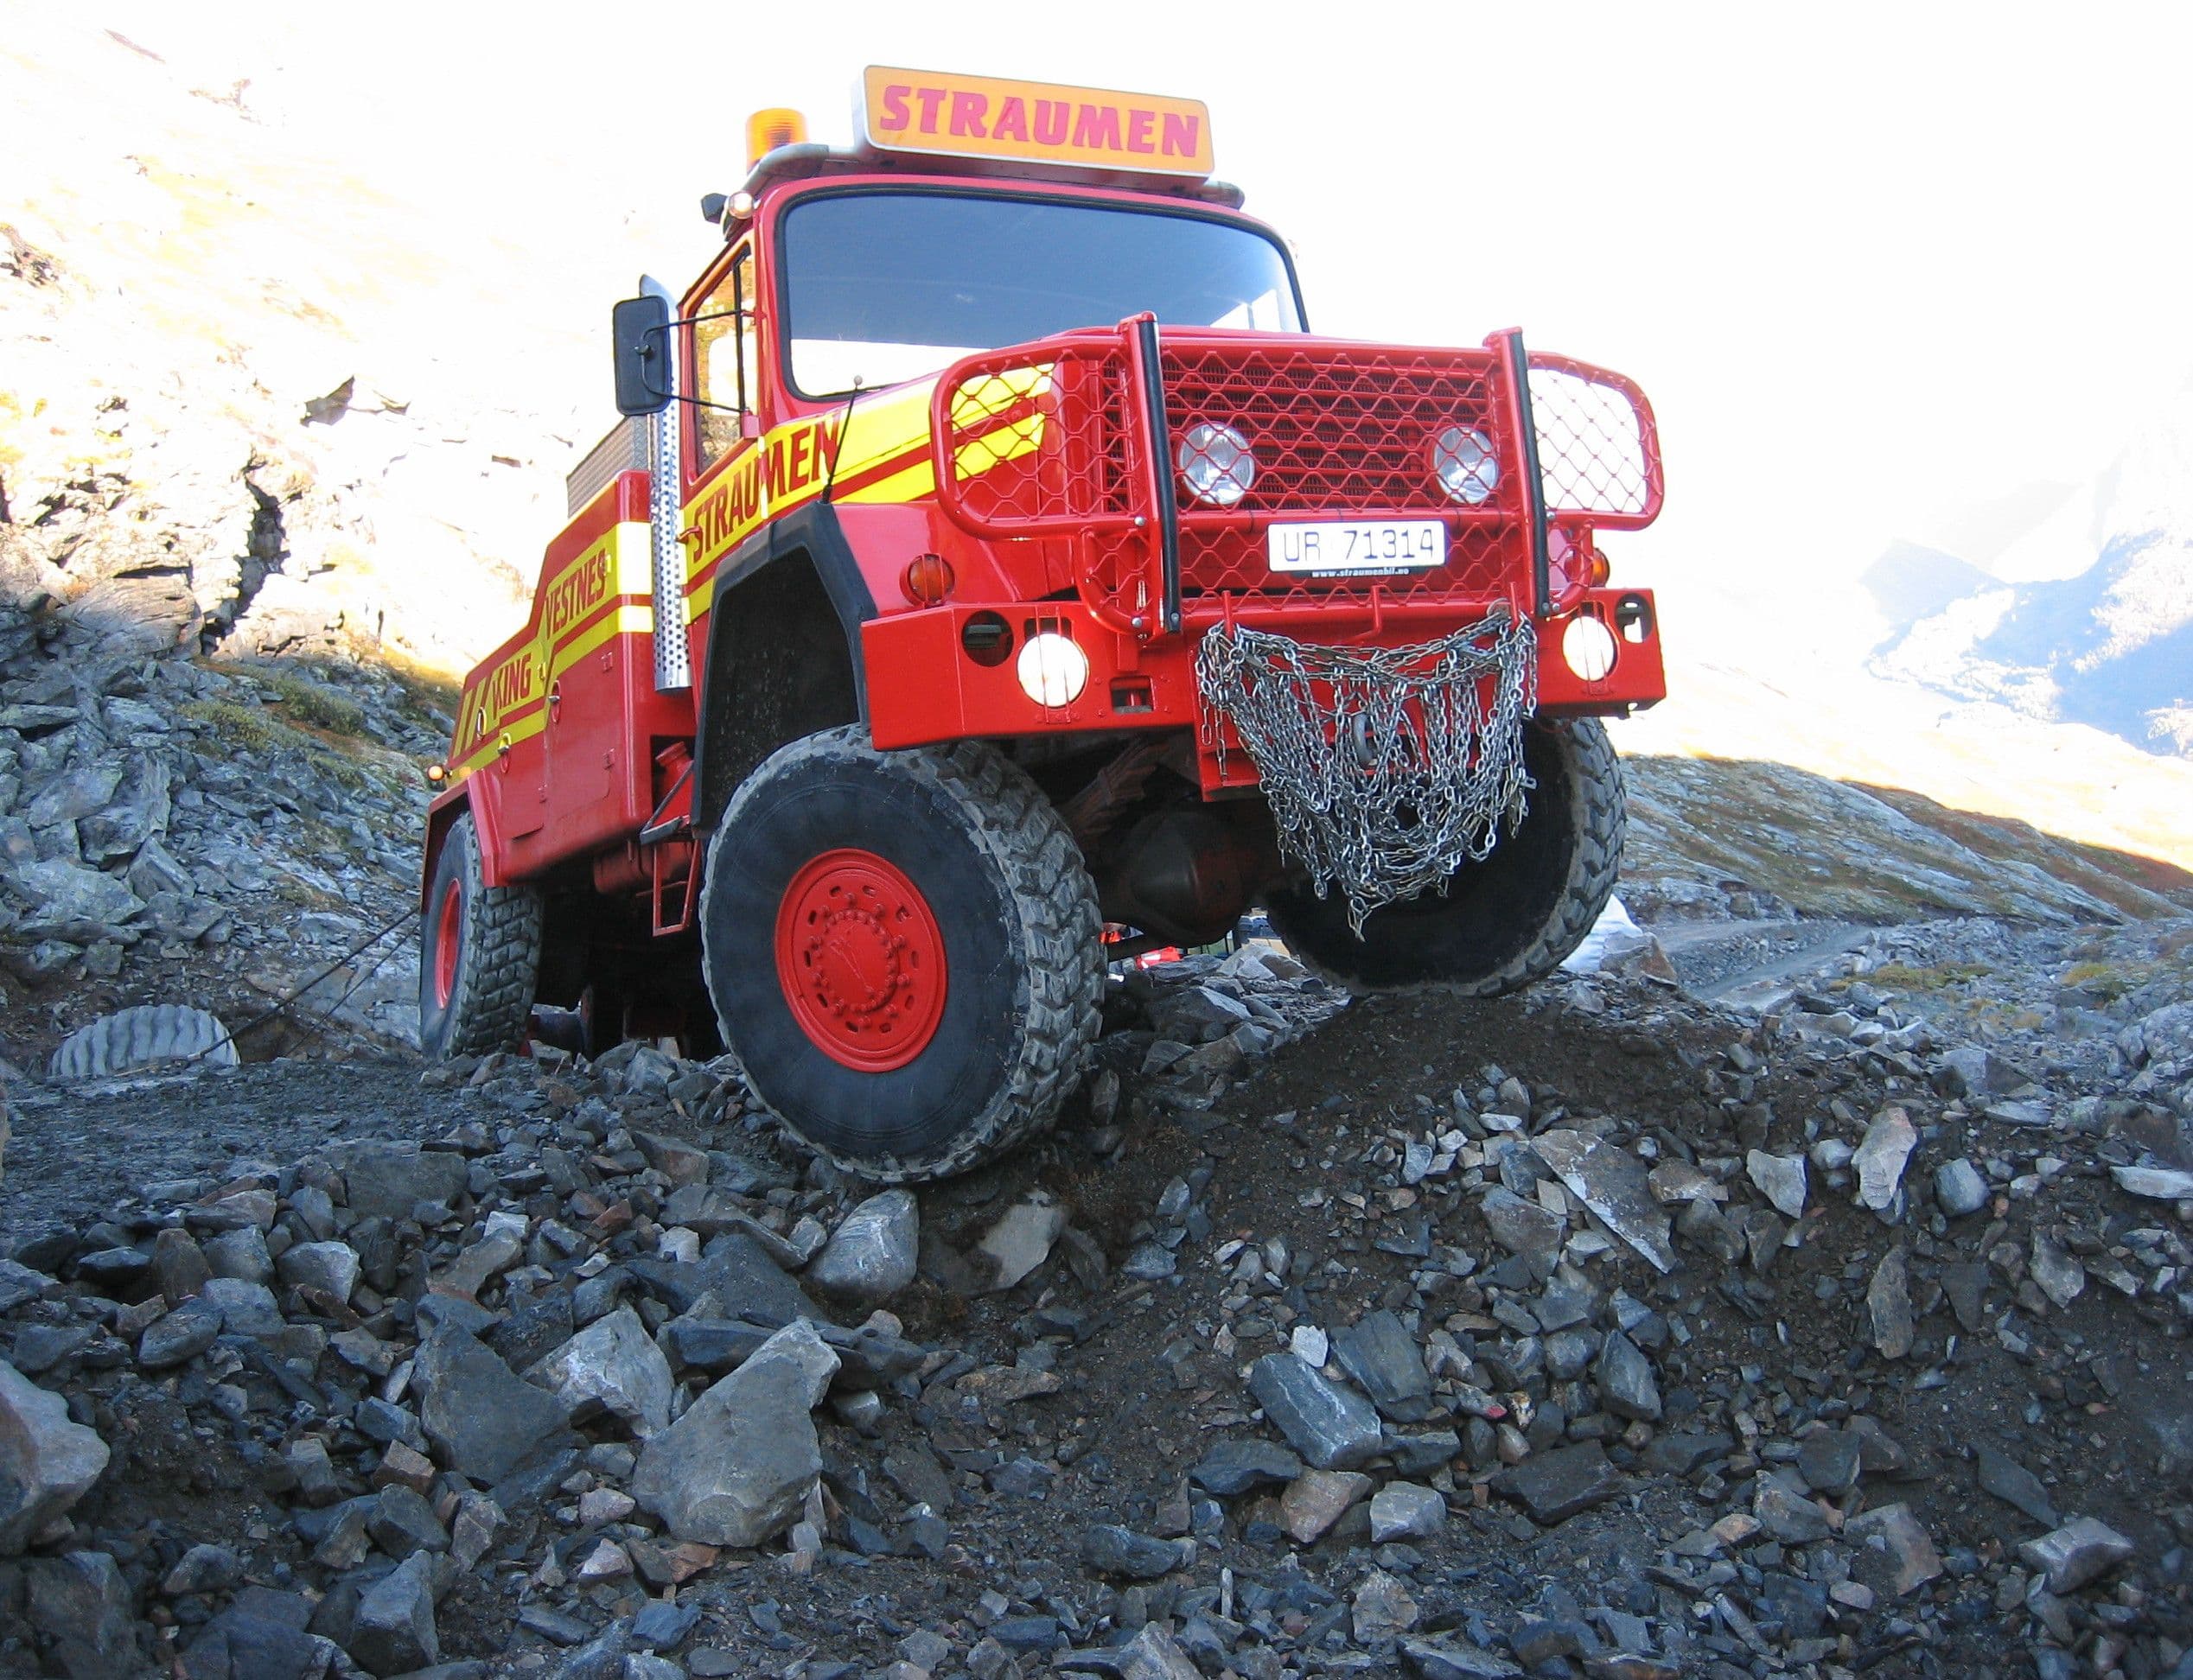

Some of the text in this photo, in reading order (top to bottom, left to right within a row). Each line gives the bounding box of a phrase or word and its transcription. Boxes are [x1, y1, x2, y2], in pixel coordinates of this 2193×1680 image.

[879, 85, 1200, 157] STRAUMEN
[693, 412, 841, 563] STRAUMEN
[1283, 528, 1434, 563] UR 71314
[545, 547, 606, 640] VESTNES
[492, 652, 532, 721] VKING
